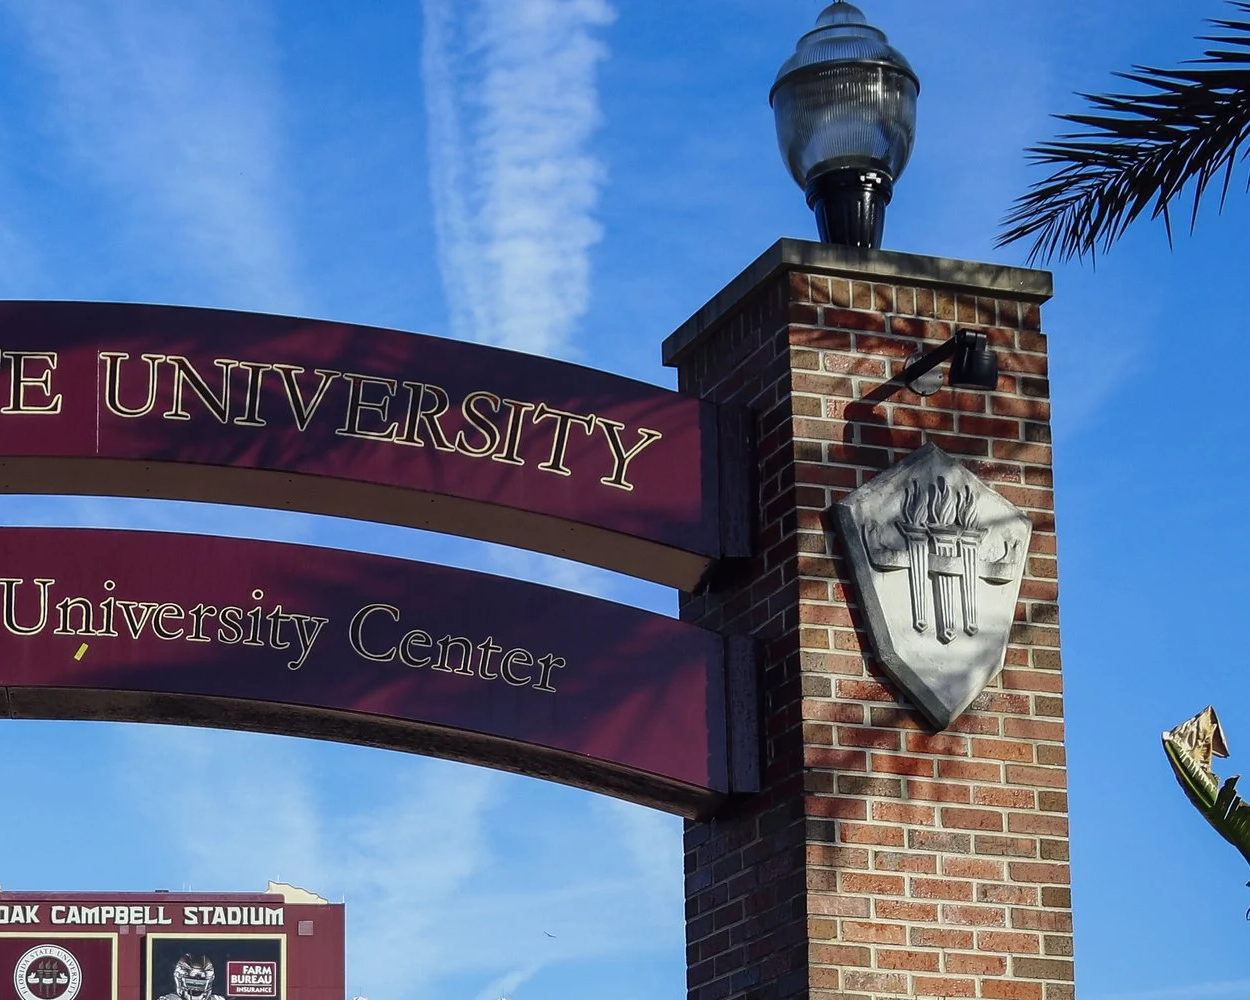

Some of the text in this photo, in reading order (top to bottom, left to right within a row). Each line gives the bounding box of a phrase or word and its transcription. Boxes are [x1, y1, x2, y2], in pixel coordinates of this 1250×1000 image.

[99, 351, 662, 491] UNIVERSITY
[349, 602, 566, 694] Center
[51, 905, 172, 925] CAMPBELL
[183, 906, 285, 926] STADIUM
[17, 949, 78, 995] FLORIDA STATE UNIVERSITY
[231, 975, 272, 984] BUREAU
[243, 965, 272, 975] FARM
